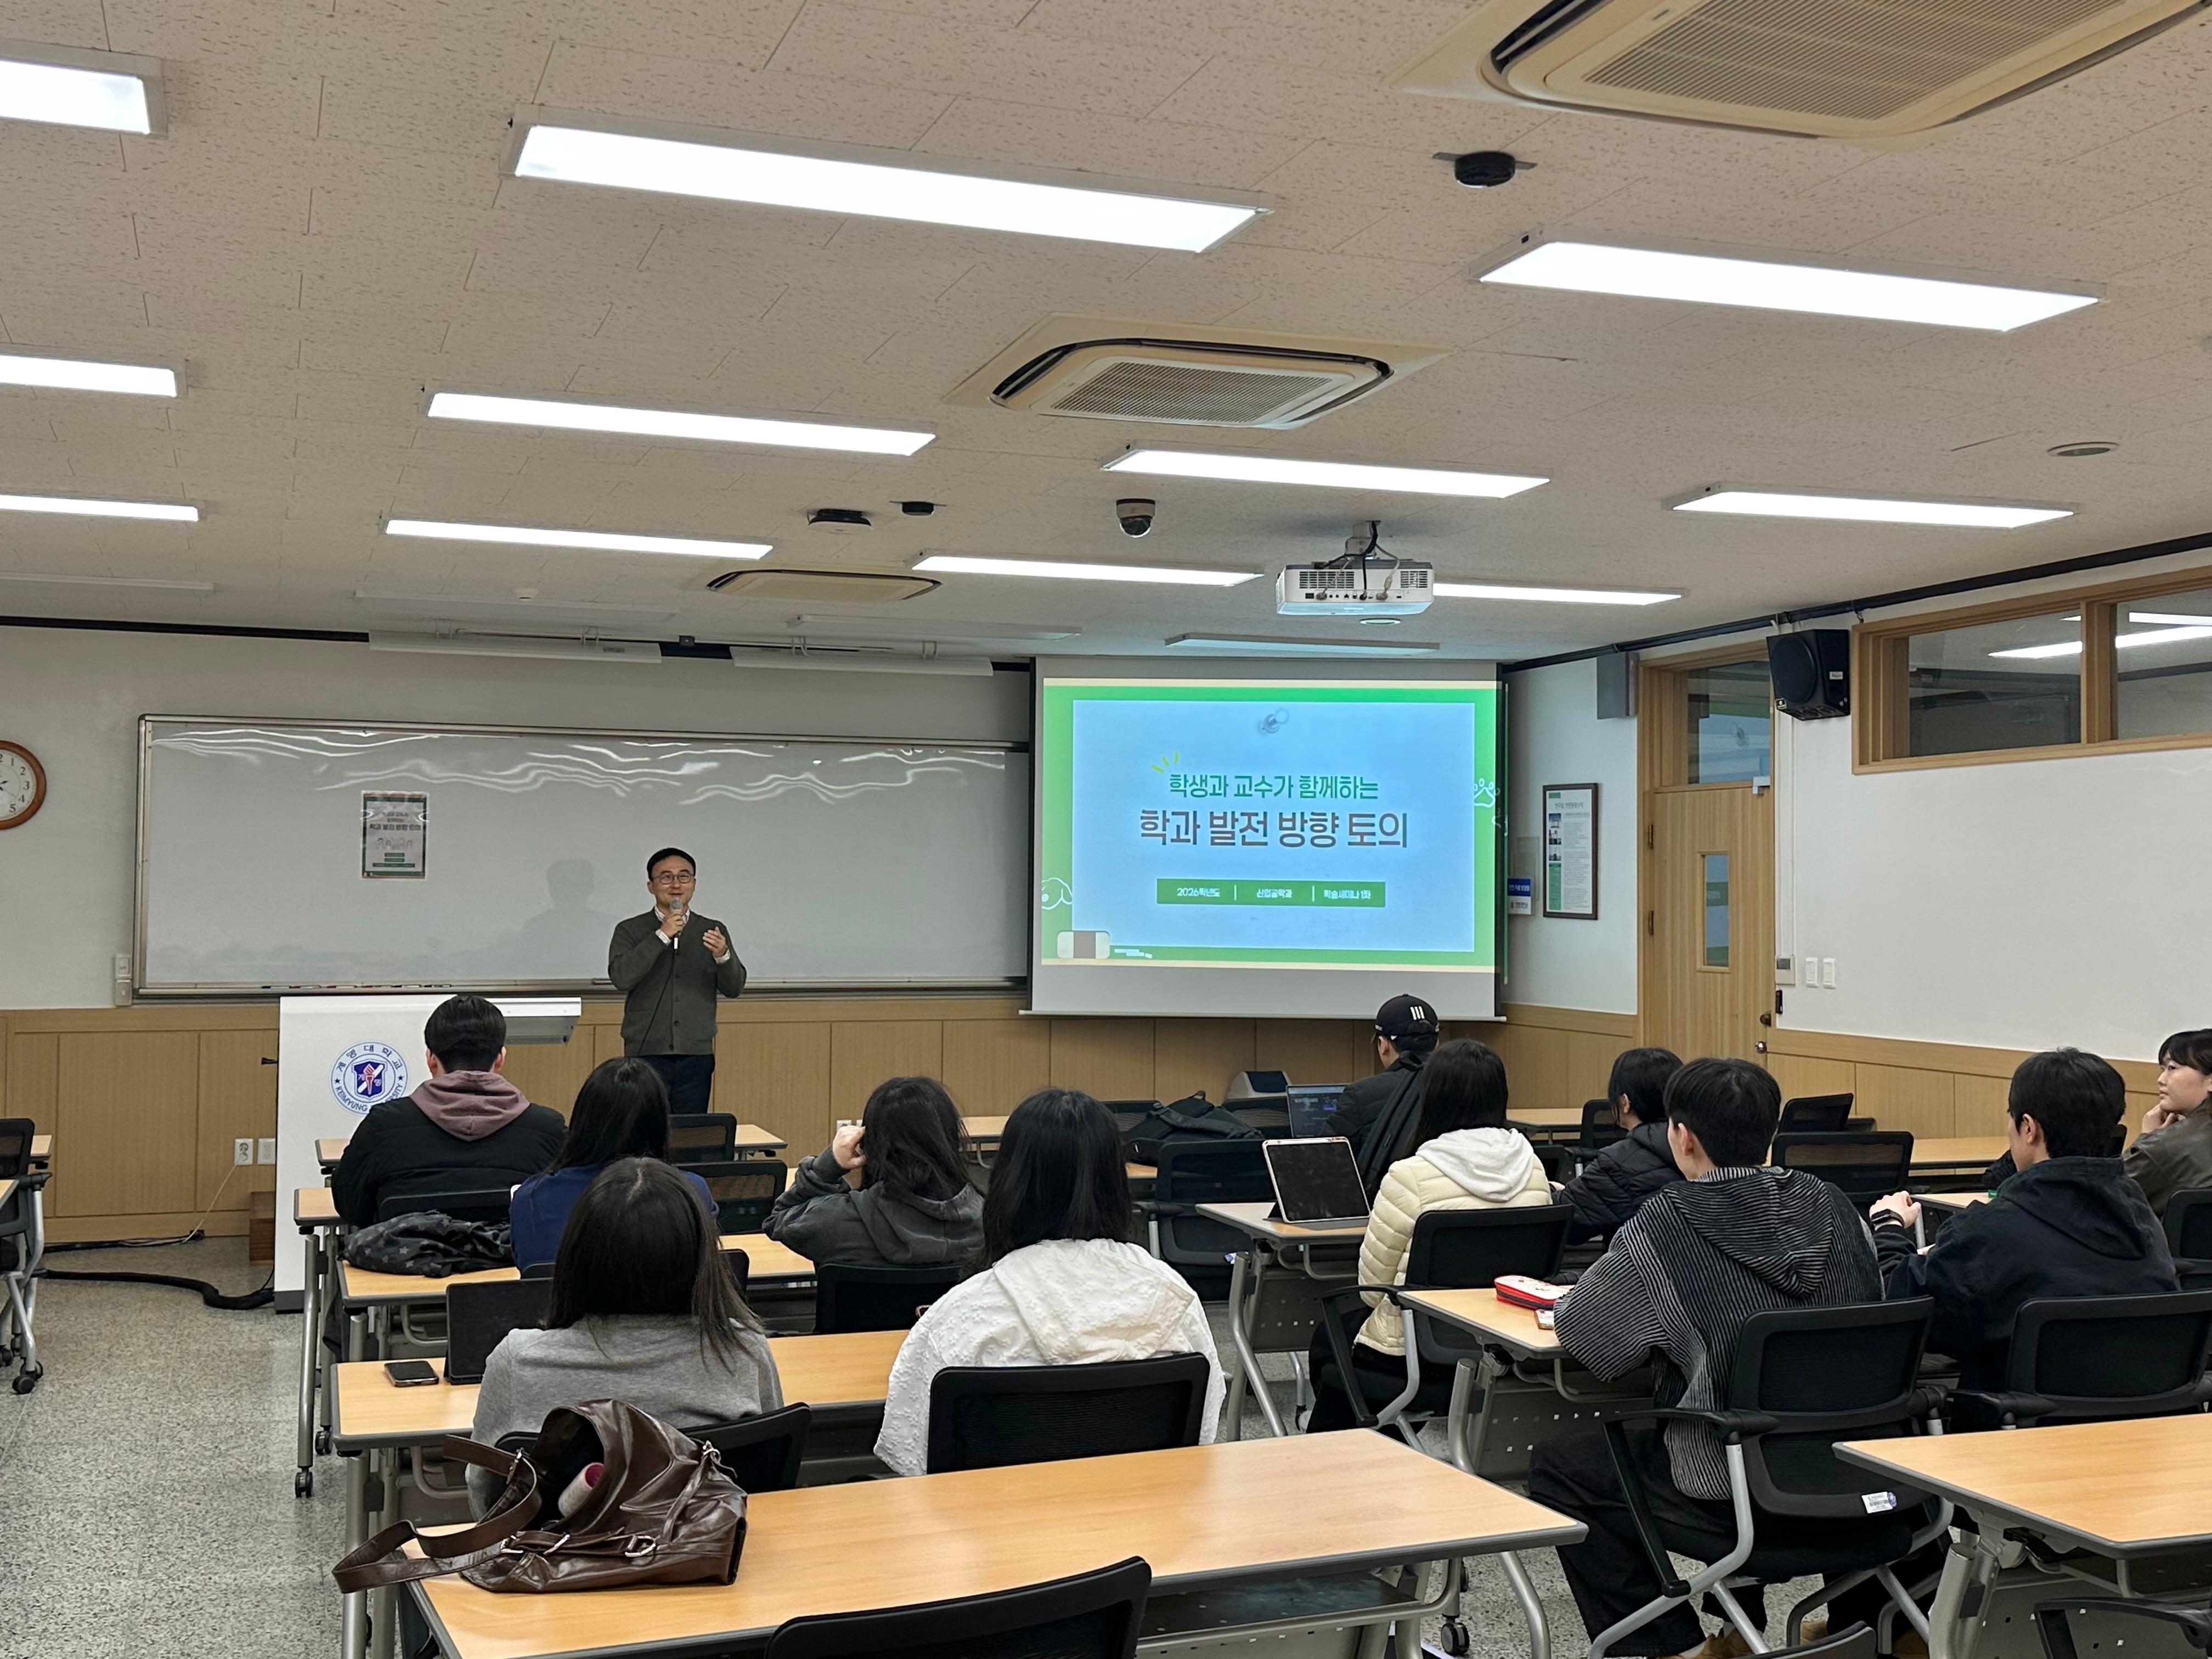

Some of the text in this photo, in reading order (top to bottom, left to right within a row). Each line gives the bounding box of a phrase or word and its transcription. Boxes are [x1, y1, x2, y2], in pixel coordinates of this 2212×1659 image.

[11, 758, 14, 766] 1
[20, 766, 26, 776] 2
[22, 781, 30, 790] 3
[1170, 774, 1379, 800] 학생과 교수가 함께하는
[18, 794, 25, 803] 4
[9, 803, 16, 813] 5
[1140, 808, 1408, 849] 학과 발전 방향 토의
[1176, 887, 1221, 898] 2026학년도
[1256, 889, 1293, 899] 산업공학과
[336, 1045, 403, 1072] 계명대학교
[336, 1086, 368, 1112] KEIMYUNG
